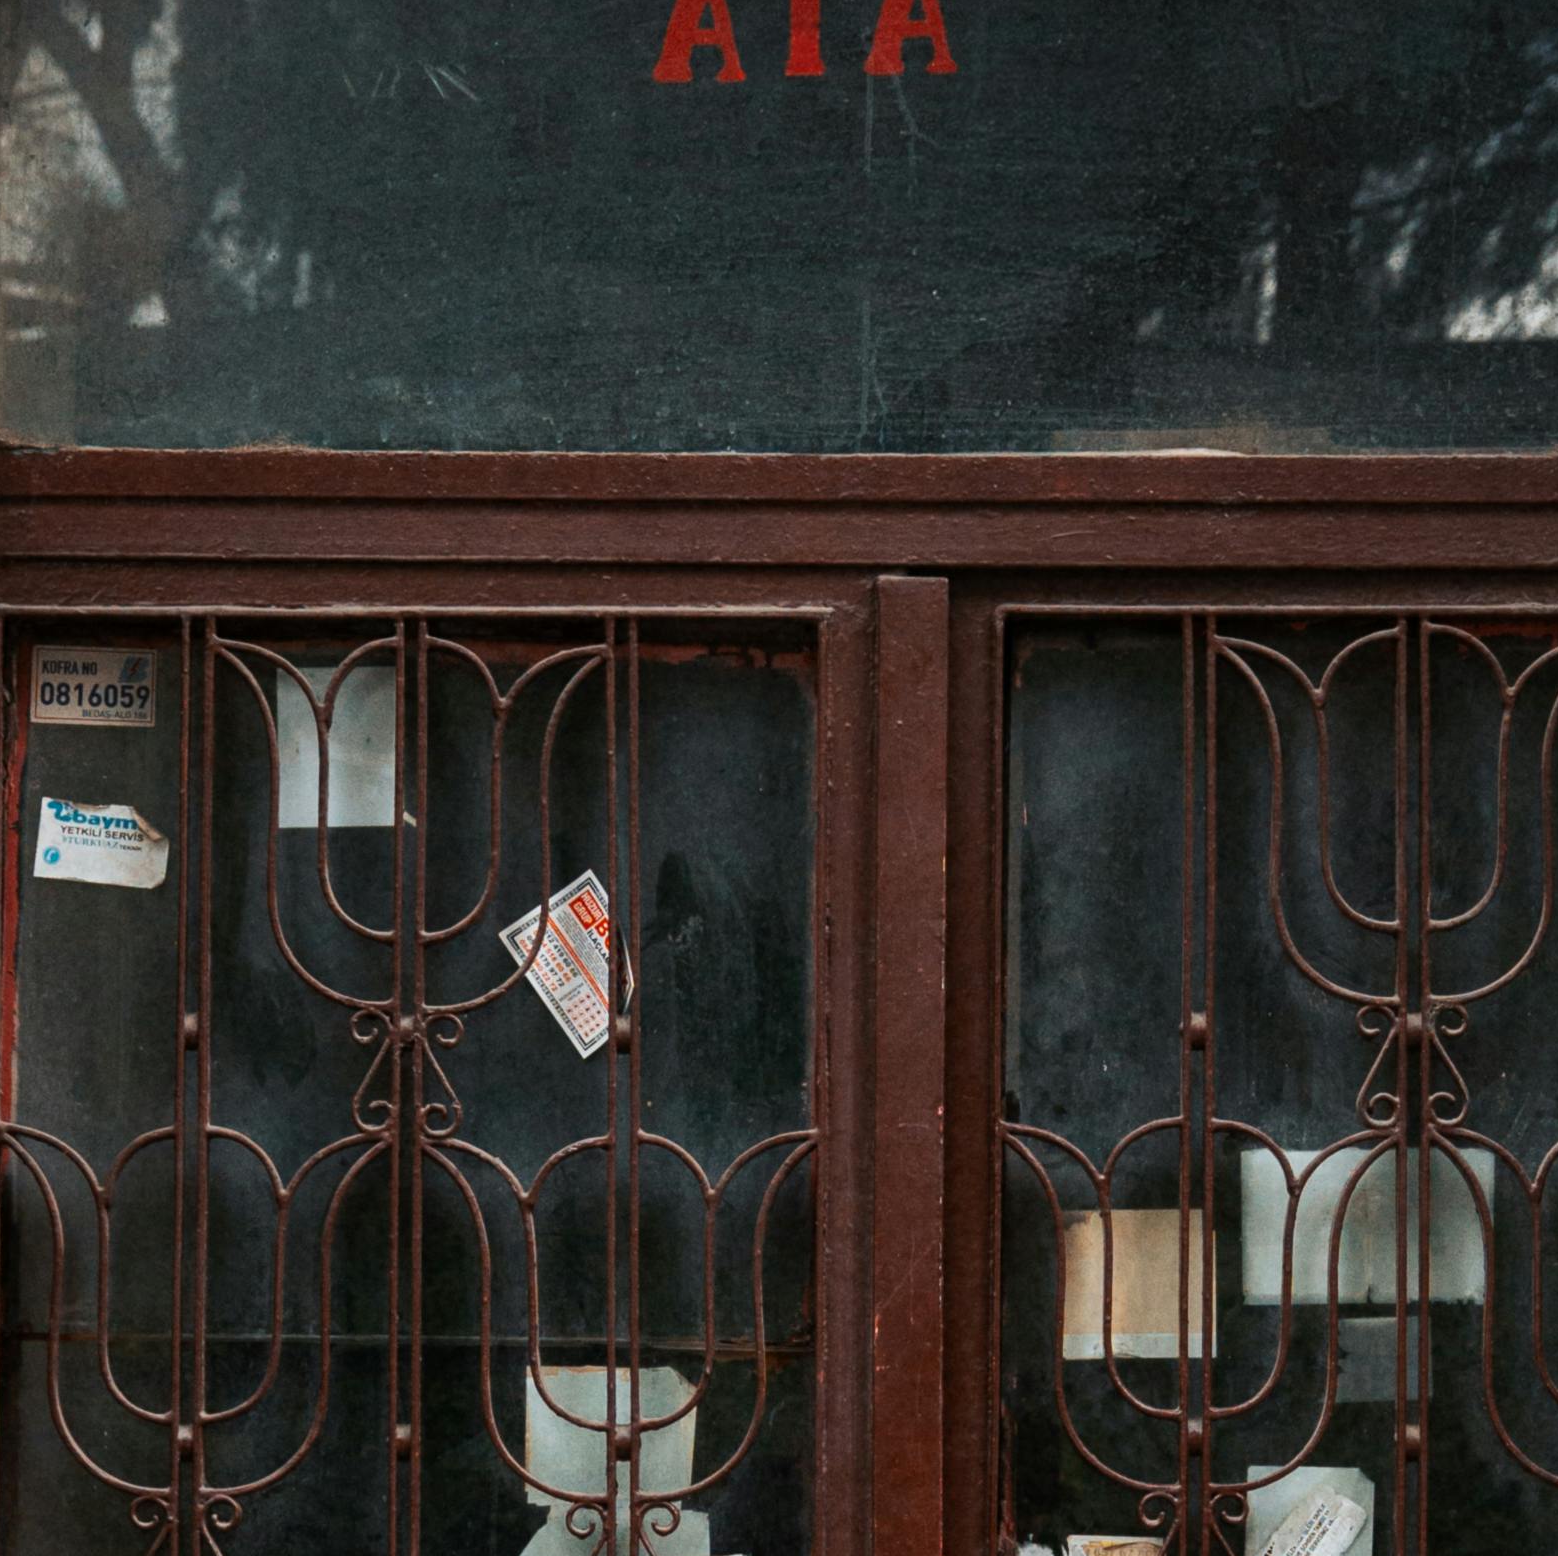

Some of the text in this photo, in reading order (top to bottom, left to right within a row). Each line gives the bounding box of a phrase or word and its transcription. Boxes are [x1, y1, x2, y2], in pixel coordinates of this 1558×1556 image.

[42, 660, 98, 675] KOFRA NO
[40, 682, 150, 708] 0816059
[60, 825, 144, 842] YETKİLİ SERVİS
[574, 901, 593, 926] GRUP
[580, 891, 604, 920] HUZUR
